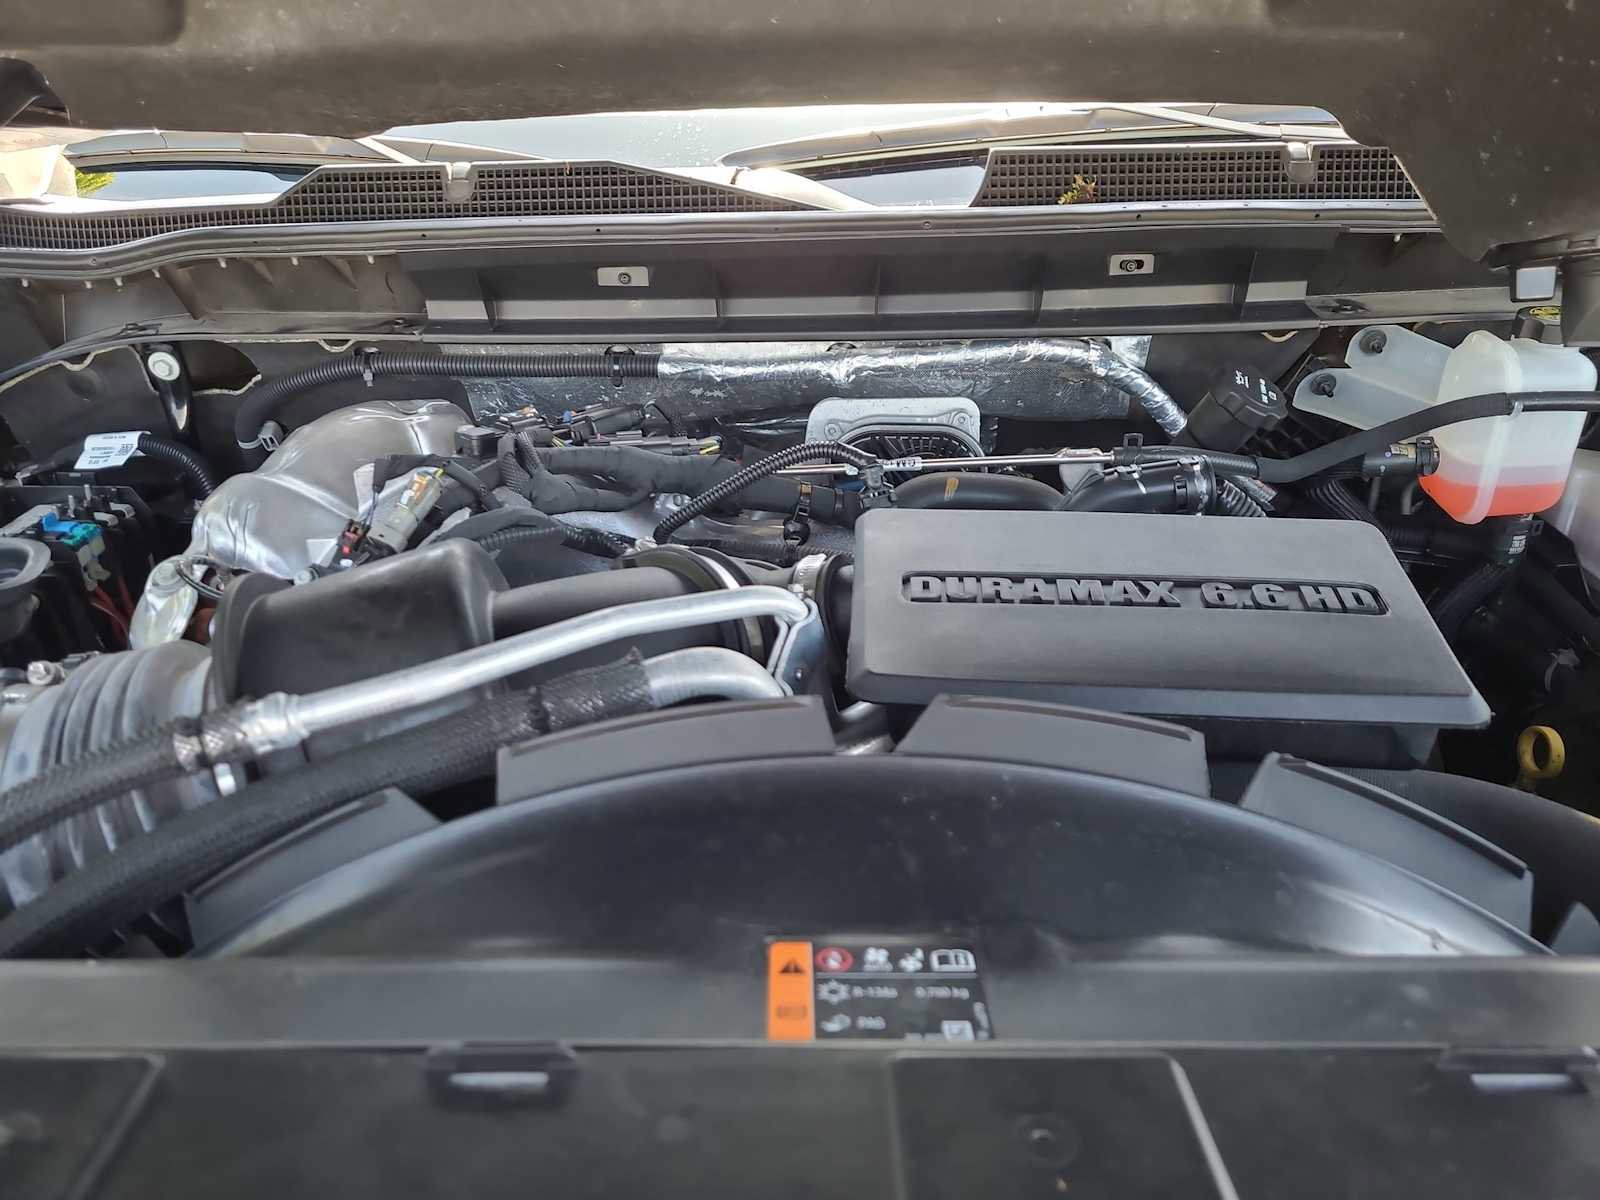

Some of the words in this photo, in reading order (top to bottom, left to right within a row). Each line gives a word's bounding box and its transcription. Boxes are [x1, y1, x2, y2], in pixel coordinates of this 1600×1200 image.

[909, 575, 1182, 607] DURAMAX
[1200, 581, 1289, 611] 6.6
[1299, 584, 1385, 614] HD
